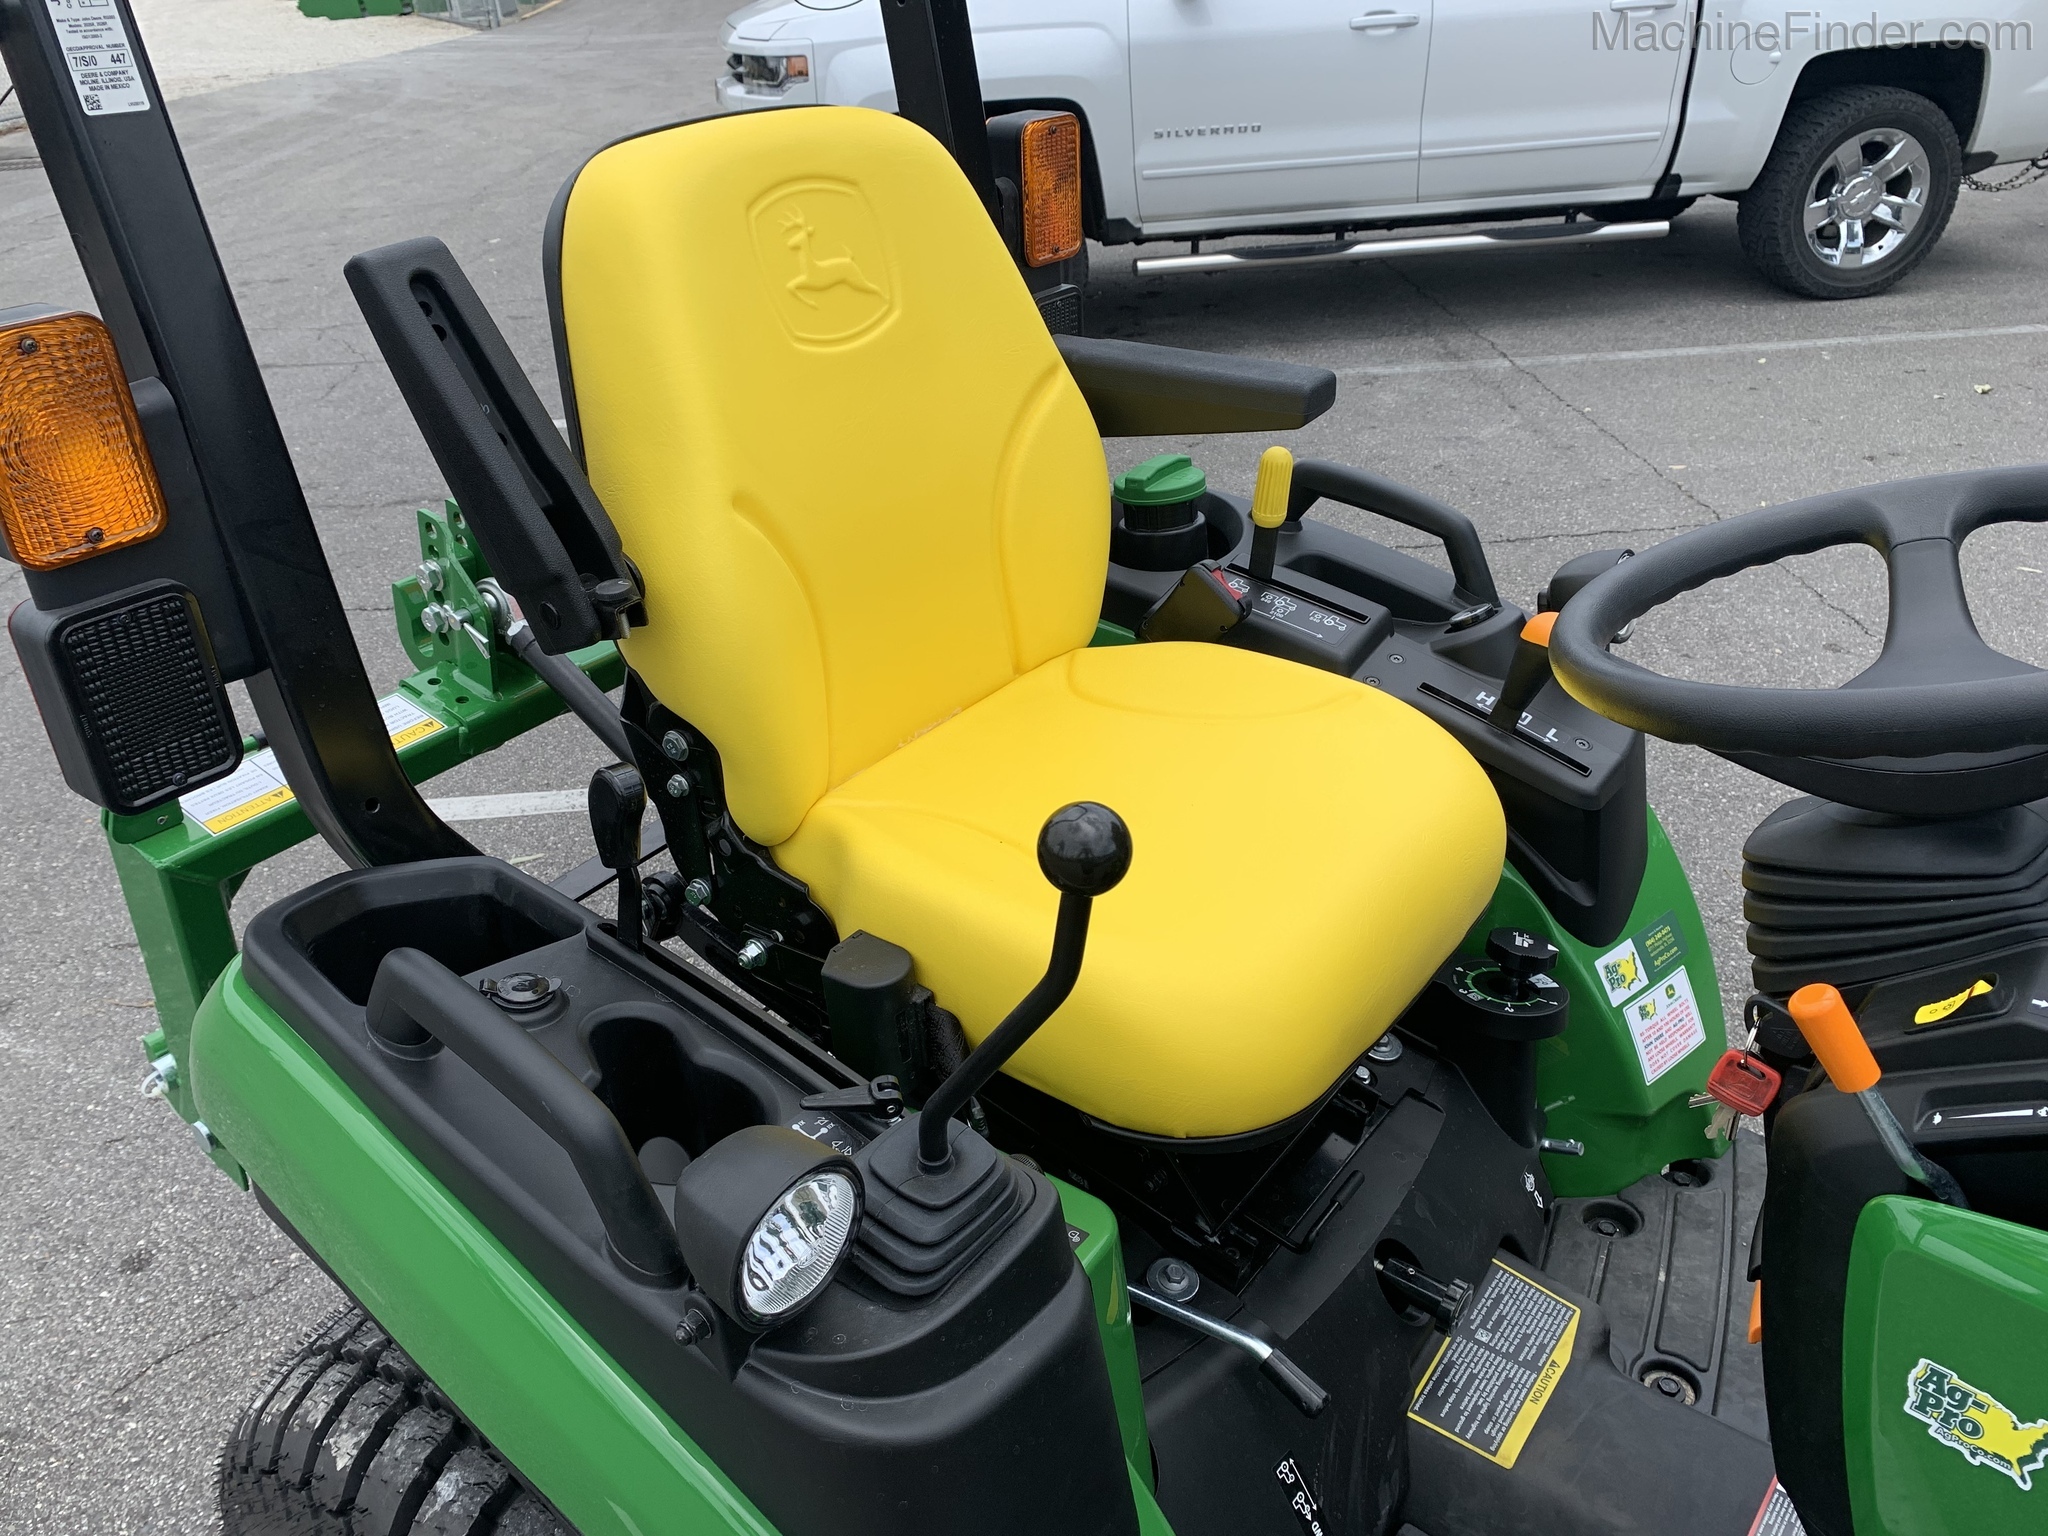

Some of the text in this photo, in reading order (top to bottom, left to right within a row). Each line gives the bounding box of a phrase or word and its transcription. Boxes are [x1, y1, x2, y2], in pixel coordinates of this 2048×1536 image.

[109, 53, 127, 64] 447
[1154, 123, 1261, 139] SILVERADO
[1475, 691, 1496, 706] H
[1546, 727, 1558, 742] L
[390, 724, 425, 746] CAUT
[216, 794, 272, 826] ATTENTION
[1609, 974, 1626, 991] Pro
[1530, 1369, 1556, 1406] CAUTION
[1915, 1364, 1990, 1414] Ag-
[1911, 1388, 1984, 1440] Pro
[1935, 1427, 2012, 1471] AgProCo.com
